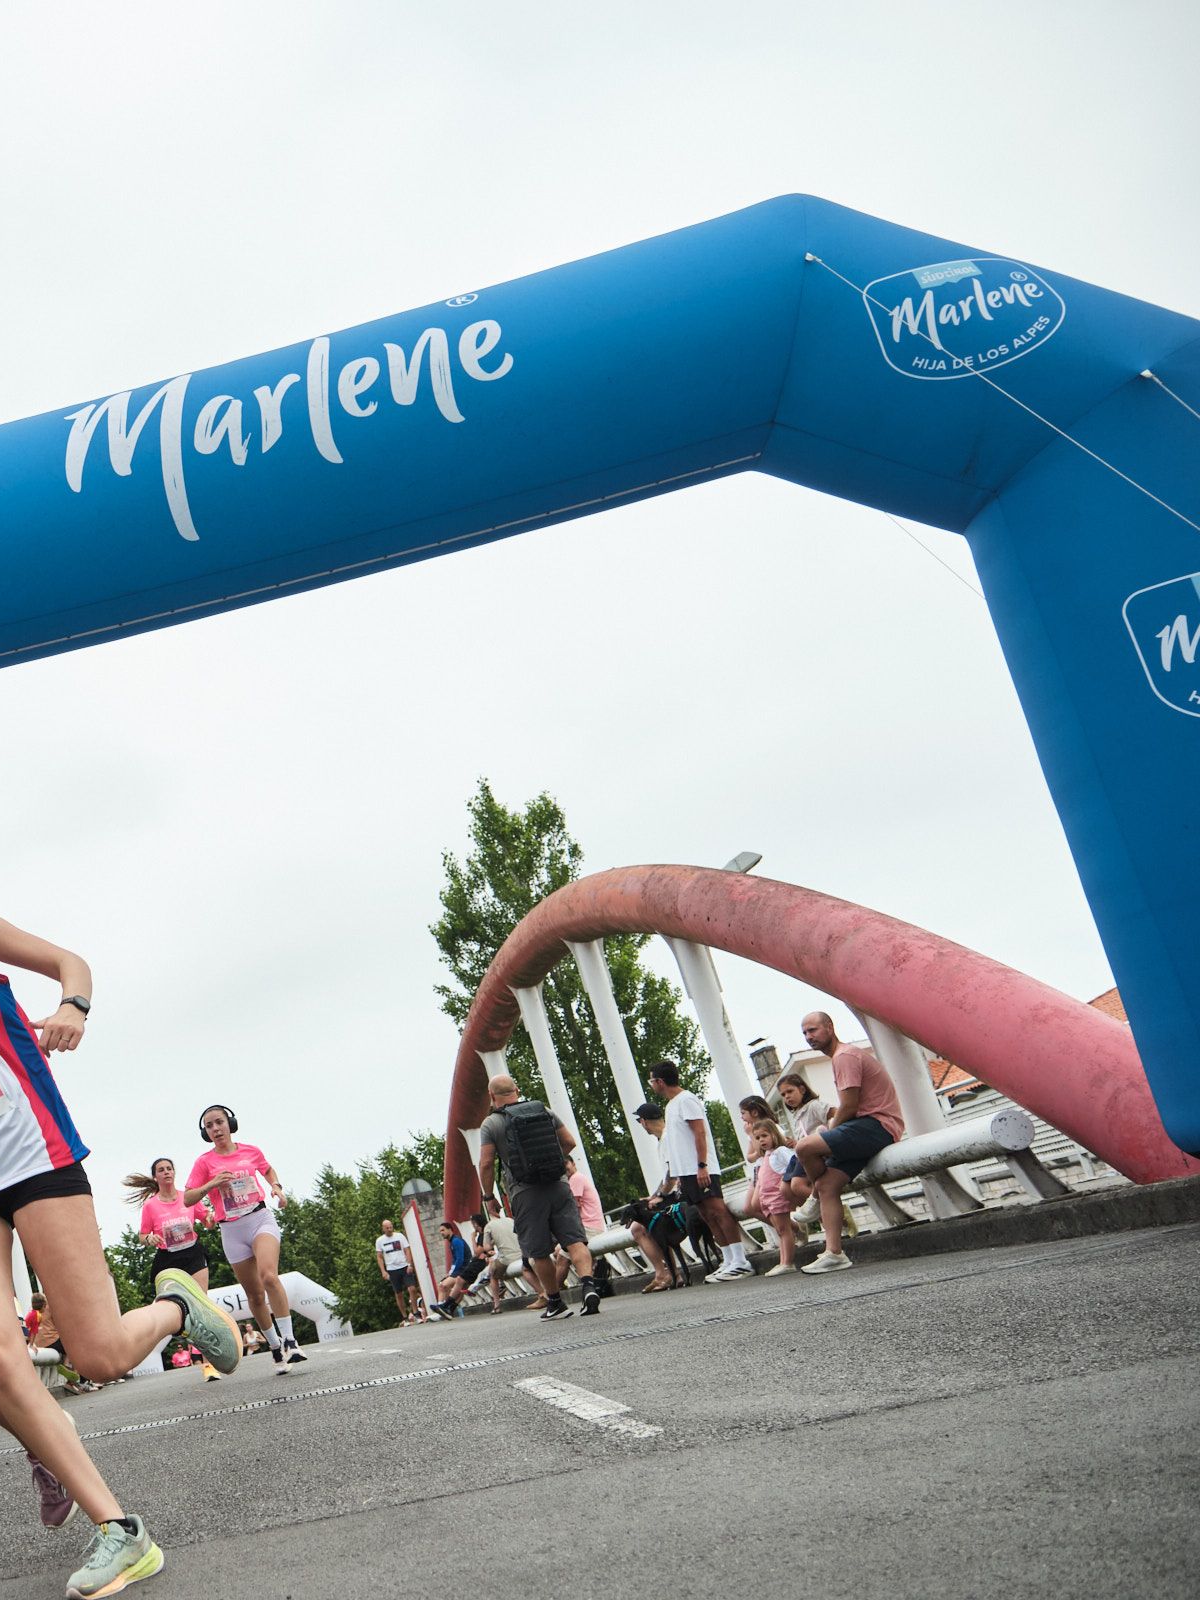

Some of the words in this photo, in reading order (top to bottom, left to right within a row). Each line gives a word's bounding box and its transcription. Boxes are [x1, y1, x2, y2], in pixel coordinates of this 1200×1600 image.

[889, 278, 1044, 350] Marlene
[912, 357, 947, 371] HIJA
[953, 356, 974, 369] DE
[978, 344, 1010, 363] LOS
[1013, 315, 1051, 349] ALPES
[64, 319, 514, 542] Marlene
